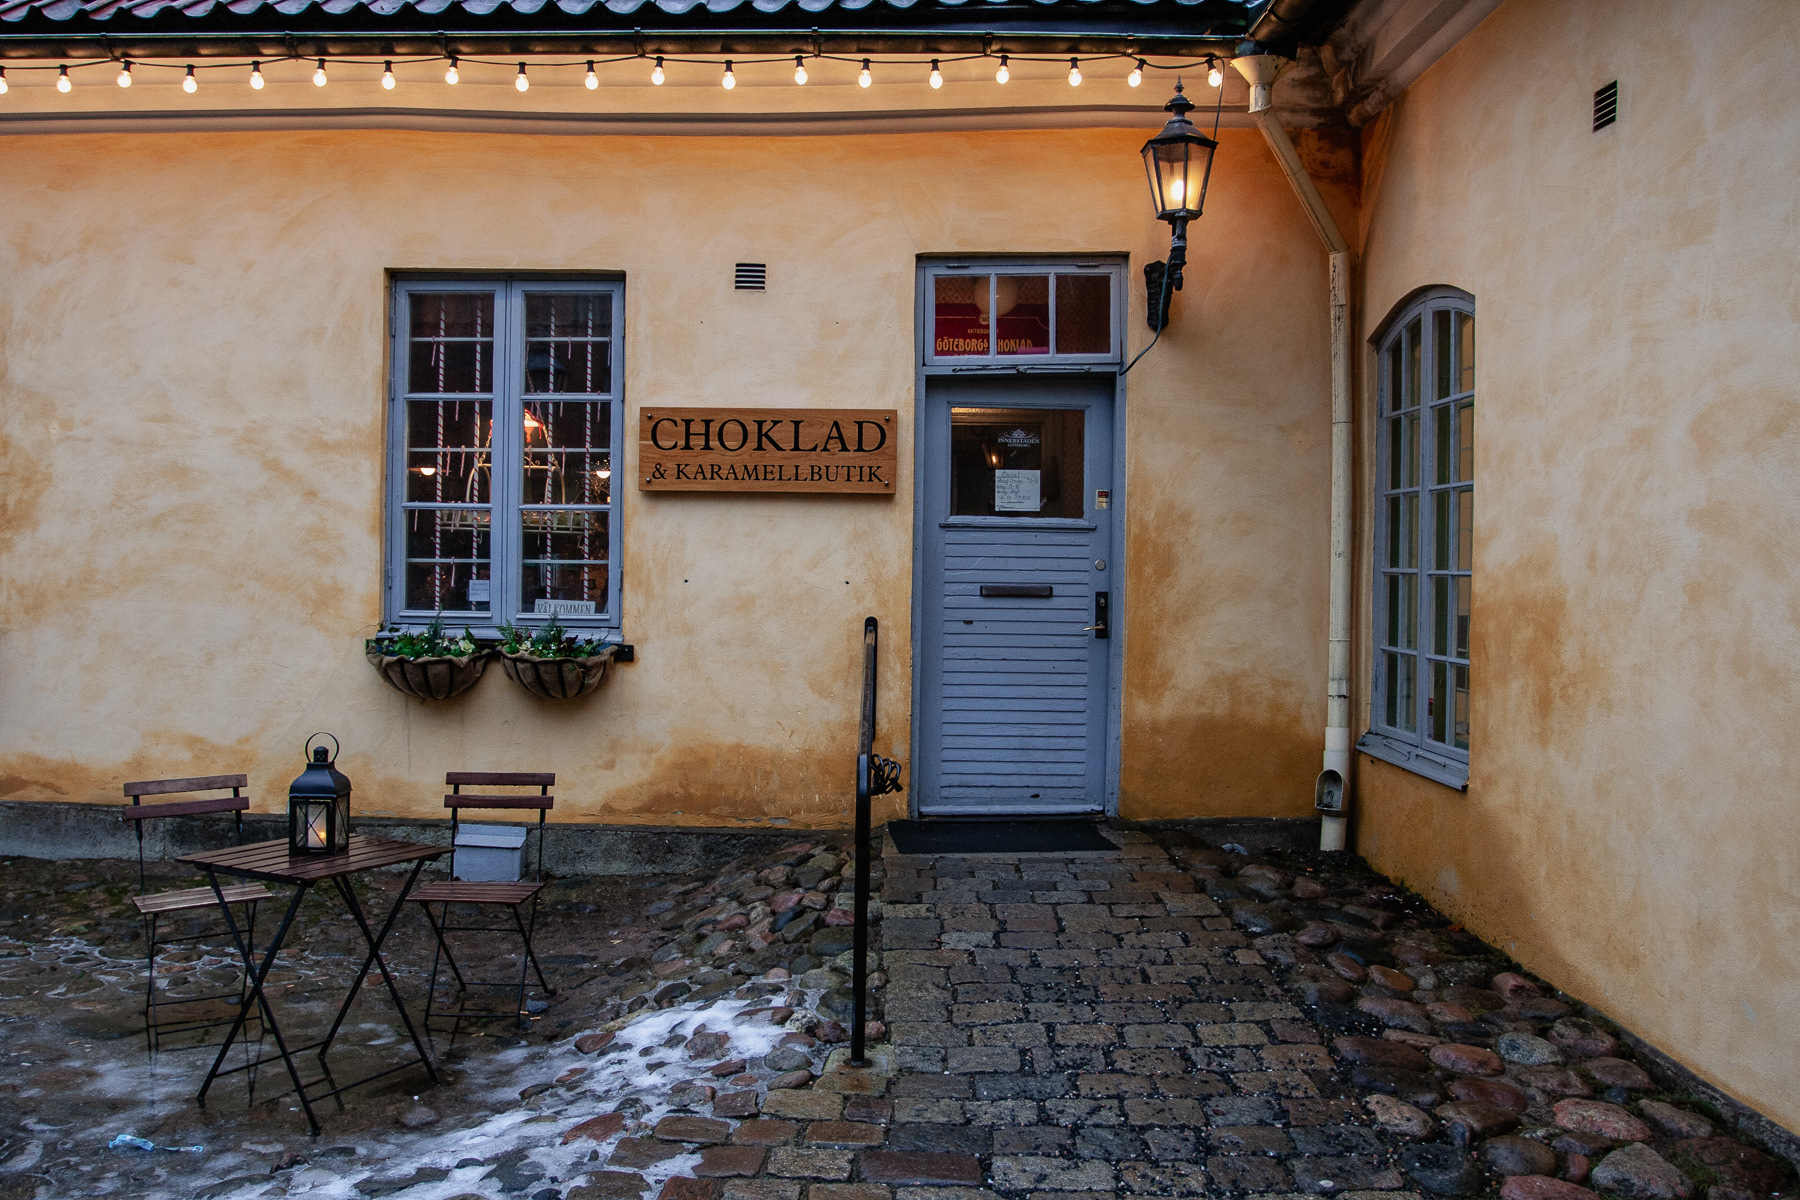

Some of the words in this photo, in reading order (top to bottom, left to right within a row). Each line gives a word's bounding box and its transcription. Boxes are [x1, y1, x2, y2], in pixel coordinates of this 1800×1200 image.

[995, 338, 1033, 352] HOKLAD
[651, 418, 887, 453] CHOKLAD
[651, 463, 667, 480] &
[675, 463, 884, 483] KARAMELLBUTIK
[537, 601, 592, 614] VÄLKOMMEN
